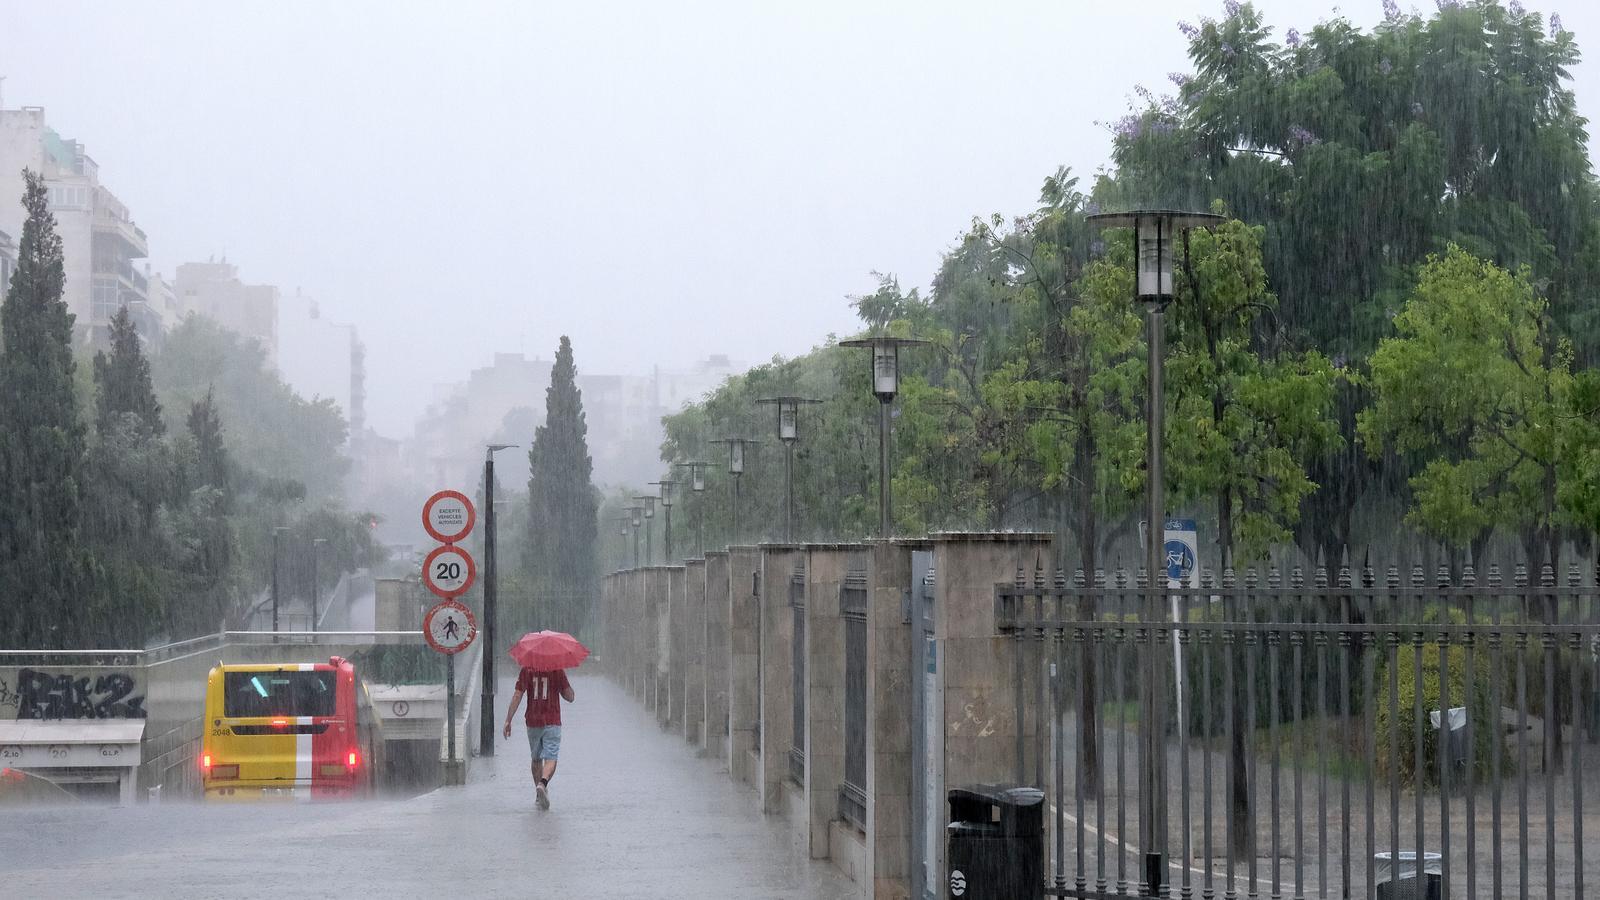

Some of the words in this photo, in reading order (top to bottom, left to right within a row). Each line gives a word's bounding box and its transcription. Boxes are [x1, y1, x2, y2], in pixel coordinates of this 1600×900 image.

[436, 562, 461, 580] 20
[532, 677, 548, 700] 11
[212, 728, 231, 737] 2048
[52, 750, 67, 759] 20
